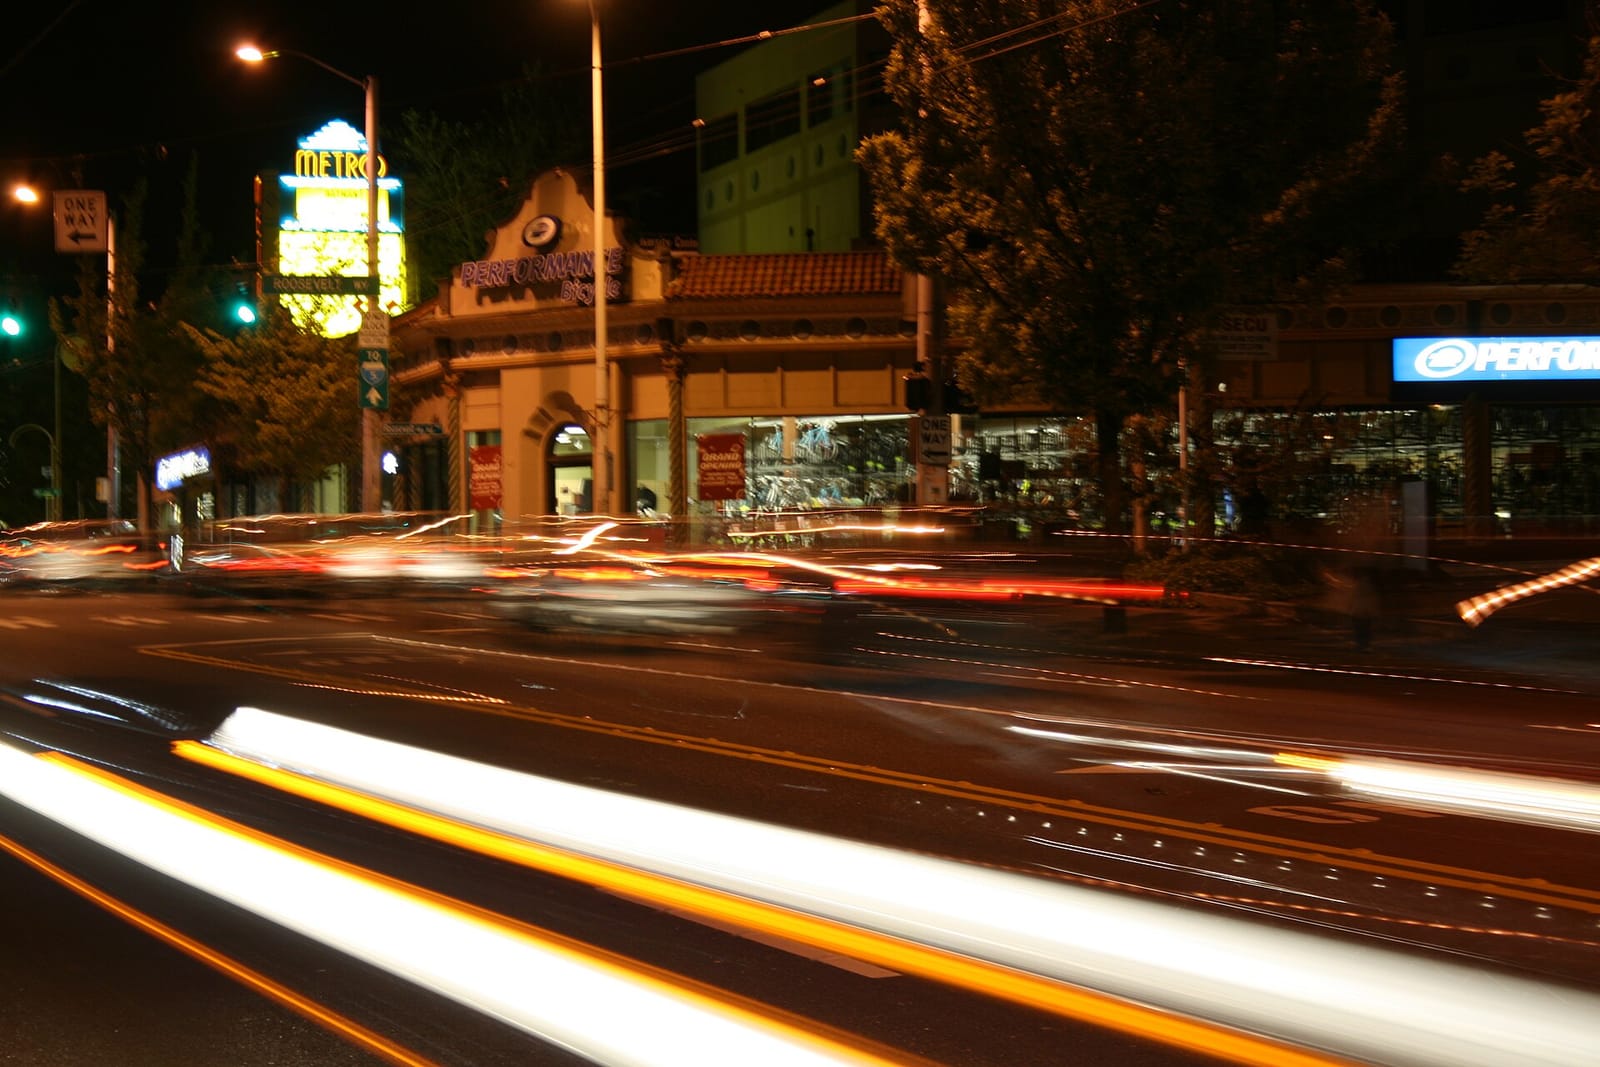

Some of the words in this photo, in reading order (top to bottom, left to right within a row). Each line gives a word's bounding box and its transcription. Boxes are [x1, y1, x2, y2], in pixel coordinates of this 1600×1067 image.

[296, 150, 387, 180] METRO
[64, 198, 97, 212] ONE
[64, 213, 97, 227] WAY
[461, 247, 625, 288] PERFORMANE
[273, 278, 343, 291] ROOSEVELT
[561, 276, 623, 306] Bicyle
[367, 351, 381, 361] TO
[1473, 341, 1600, 372] PERFOR
[921, 419, 949, 431] ONE
[921, 432, 949, 444] WAY
[703, 453, 740, 461] GRAND
